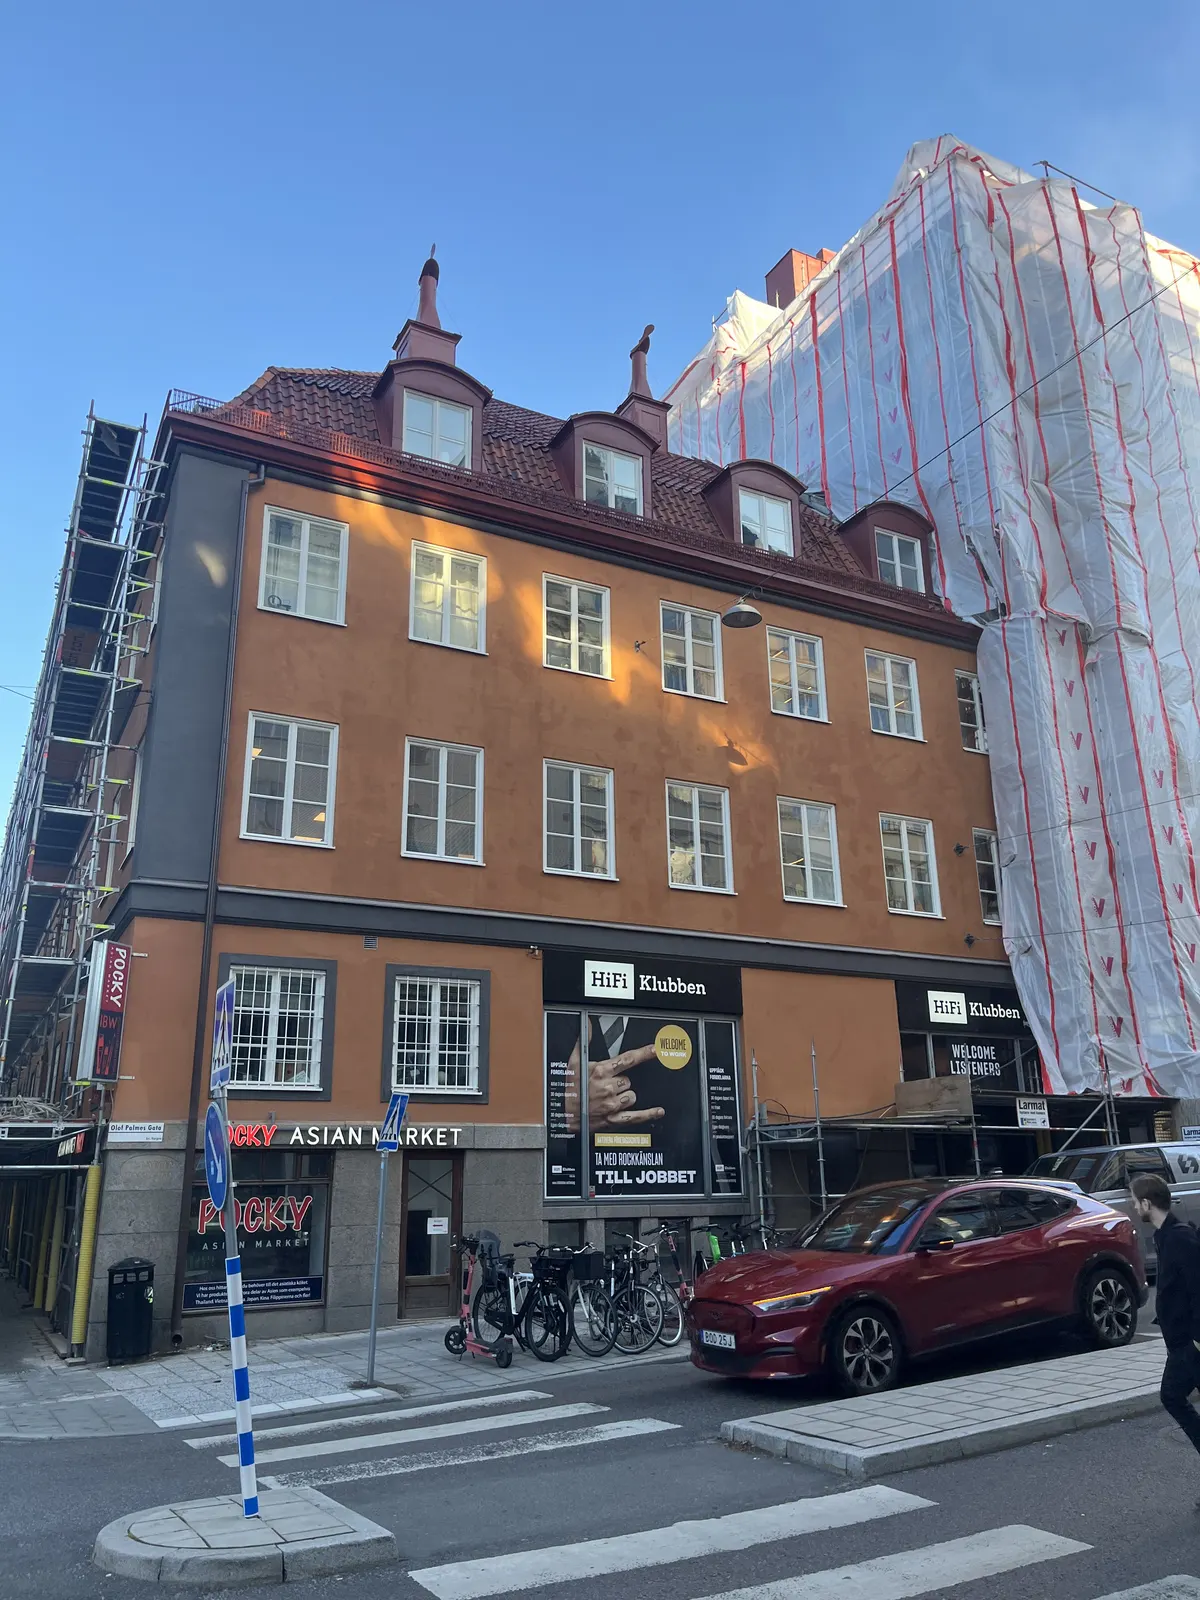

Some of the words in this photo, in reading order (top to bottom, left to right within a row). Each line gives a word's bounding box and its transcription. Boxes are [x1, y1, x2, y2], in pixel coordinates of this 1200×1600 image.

[109, 947, 127, 1008] POCKY
[591, 971, 628, 989] HiFi
[639, 974, 706, 996] Klubben
[933, 999, 962, 1015] HiFi
[968, 1001, 1021, 1019] Klubben
[660, 1037, 687, 1051] WELCOME
[951, 1043, 997, 1060] WELCOME
[950, 1060, 1001, 1077] LISTENERS
[1018, 1099, 1046, 1110] Larmat
[289, 1126, 362, 1145] ASIAN
[371, 1126, 463, 1146] MRKET
[594, 1152, 602, 1165] TA
[603, 1152, 617, 1166] MED
[618, 1150, 664, 1166] ROCKKÄNSLAN
[594, 1170, 633, 1184] TILL
[635, 1170, 697, 1184] JOBBET
[202, 1240, 245, 1251] ASIN
[255, 1238, 309, 1249] MARKET
